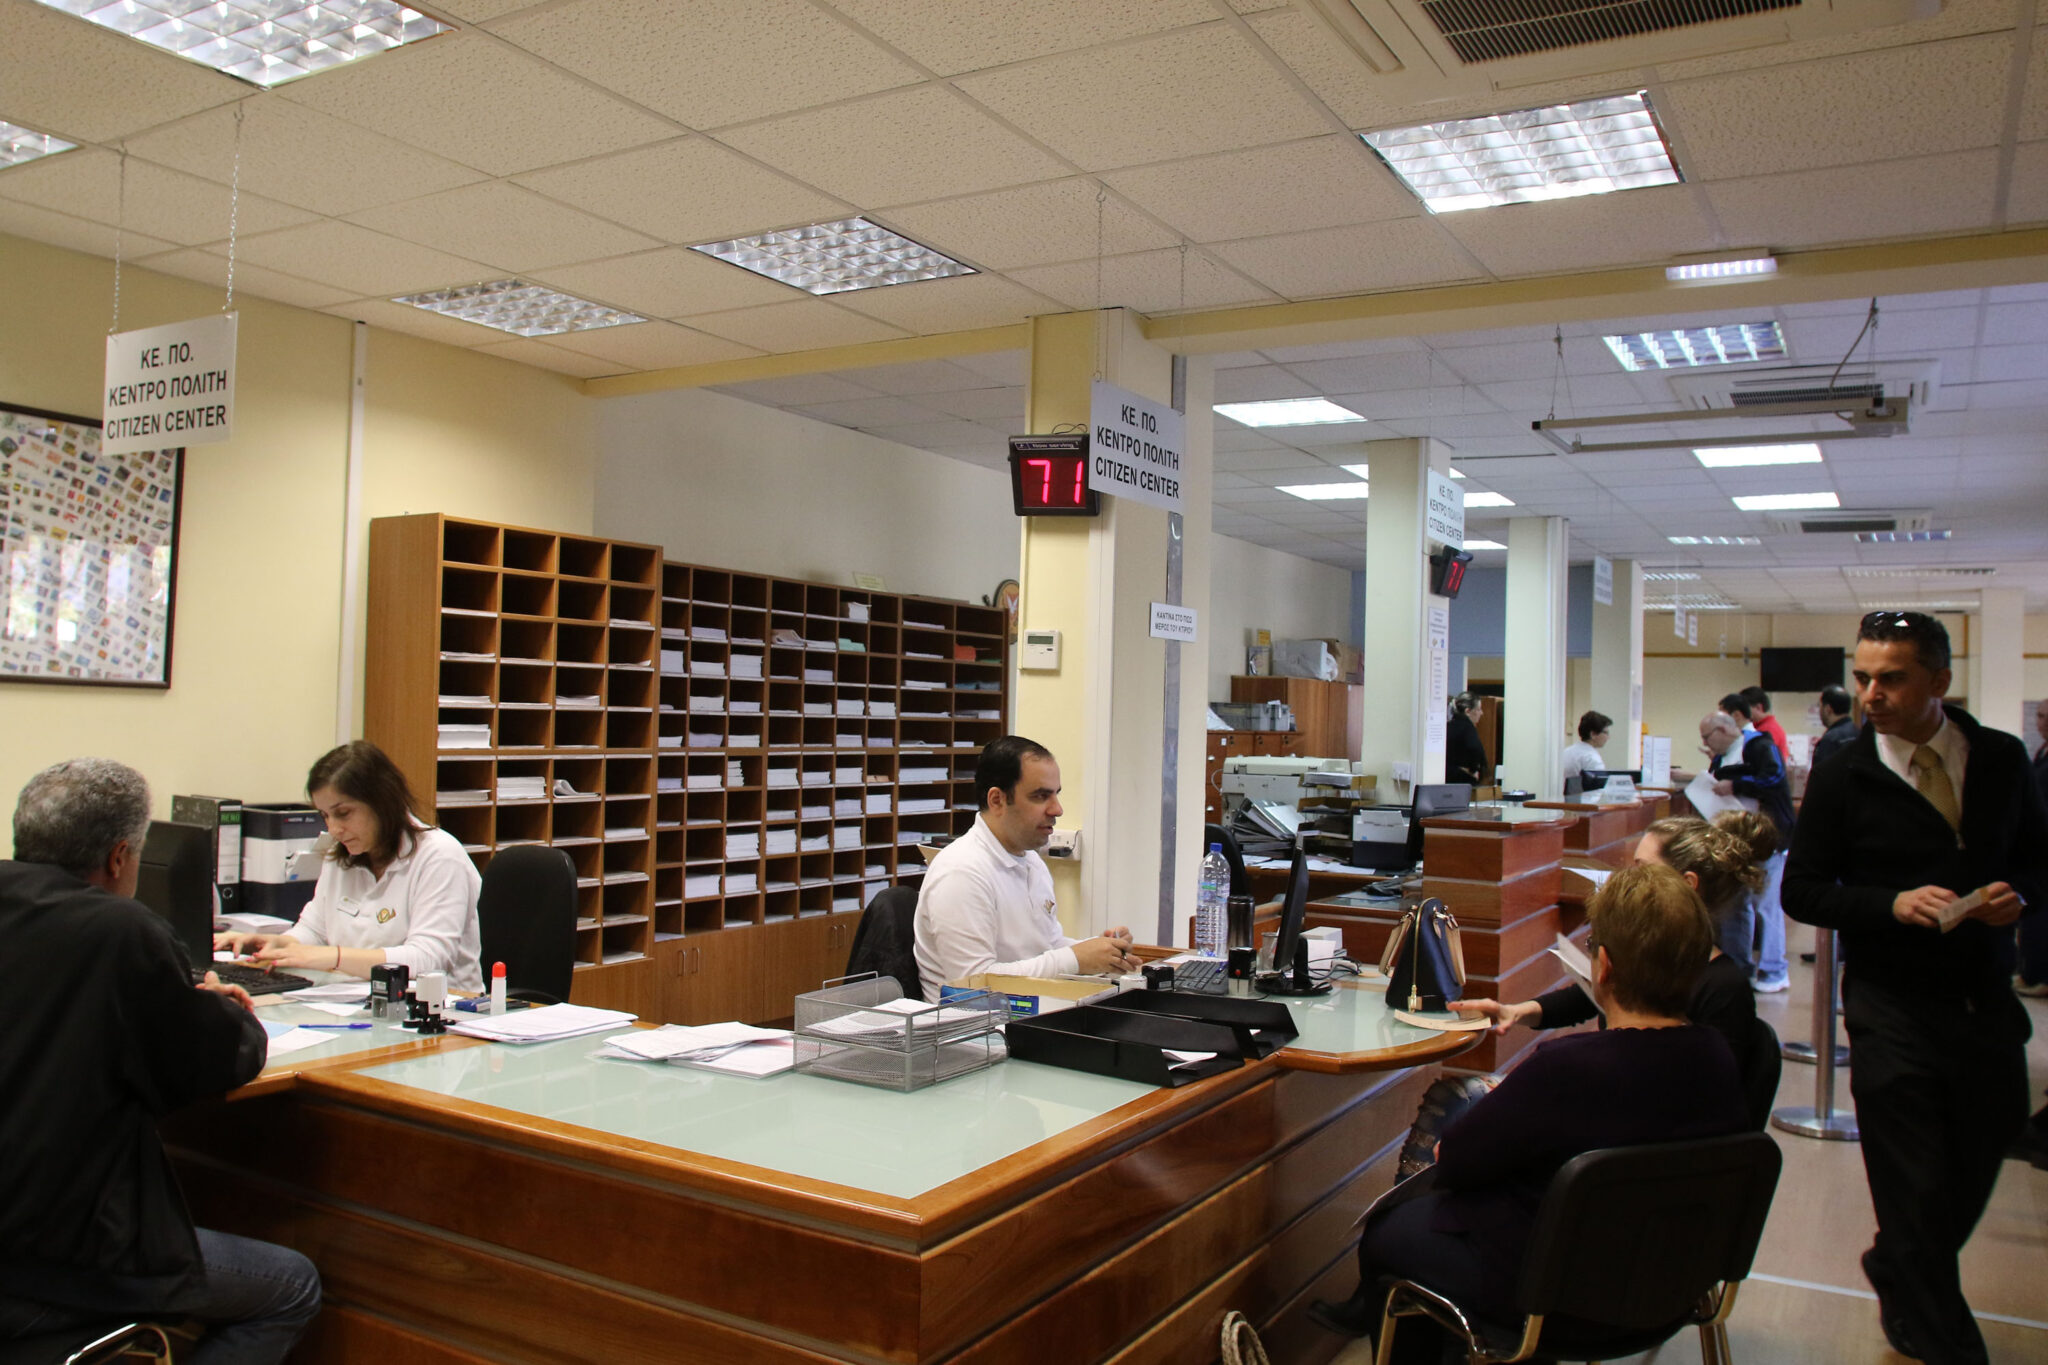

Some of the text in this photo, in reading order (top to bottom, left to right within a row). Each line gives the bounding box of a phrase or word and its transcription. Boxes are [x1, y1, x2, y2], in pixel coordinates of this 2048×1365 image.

[141, 342, 194, 369] ΚΕ. ΠΟ.
[109, 370, 227, 407] ΚΕΝΤΡΟ ΠΟΛΙΤΗ
[107, 405, 226, 439] CITIZEN CENTER
[1121, 404, 1159, 435] ΚΕ. ΠΟ.
[1097, 425, 1179, 471] ΚΕΝΤΡΟ ΠΟΛΙΤΗ
[1027, 459, 1084, 504] 71
[1095, 457, 1179, 499] CITIZEN CENTER
[1429, 516, 1462, 541] CITIZEN CENTER
[1448, 561, 1465, 593] 71
